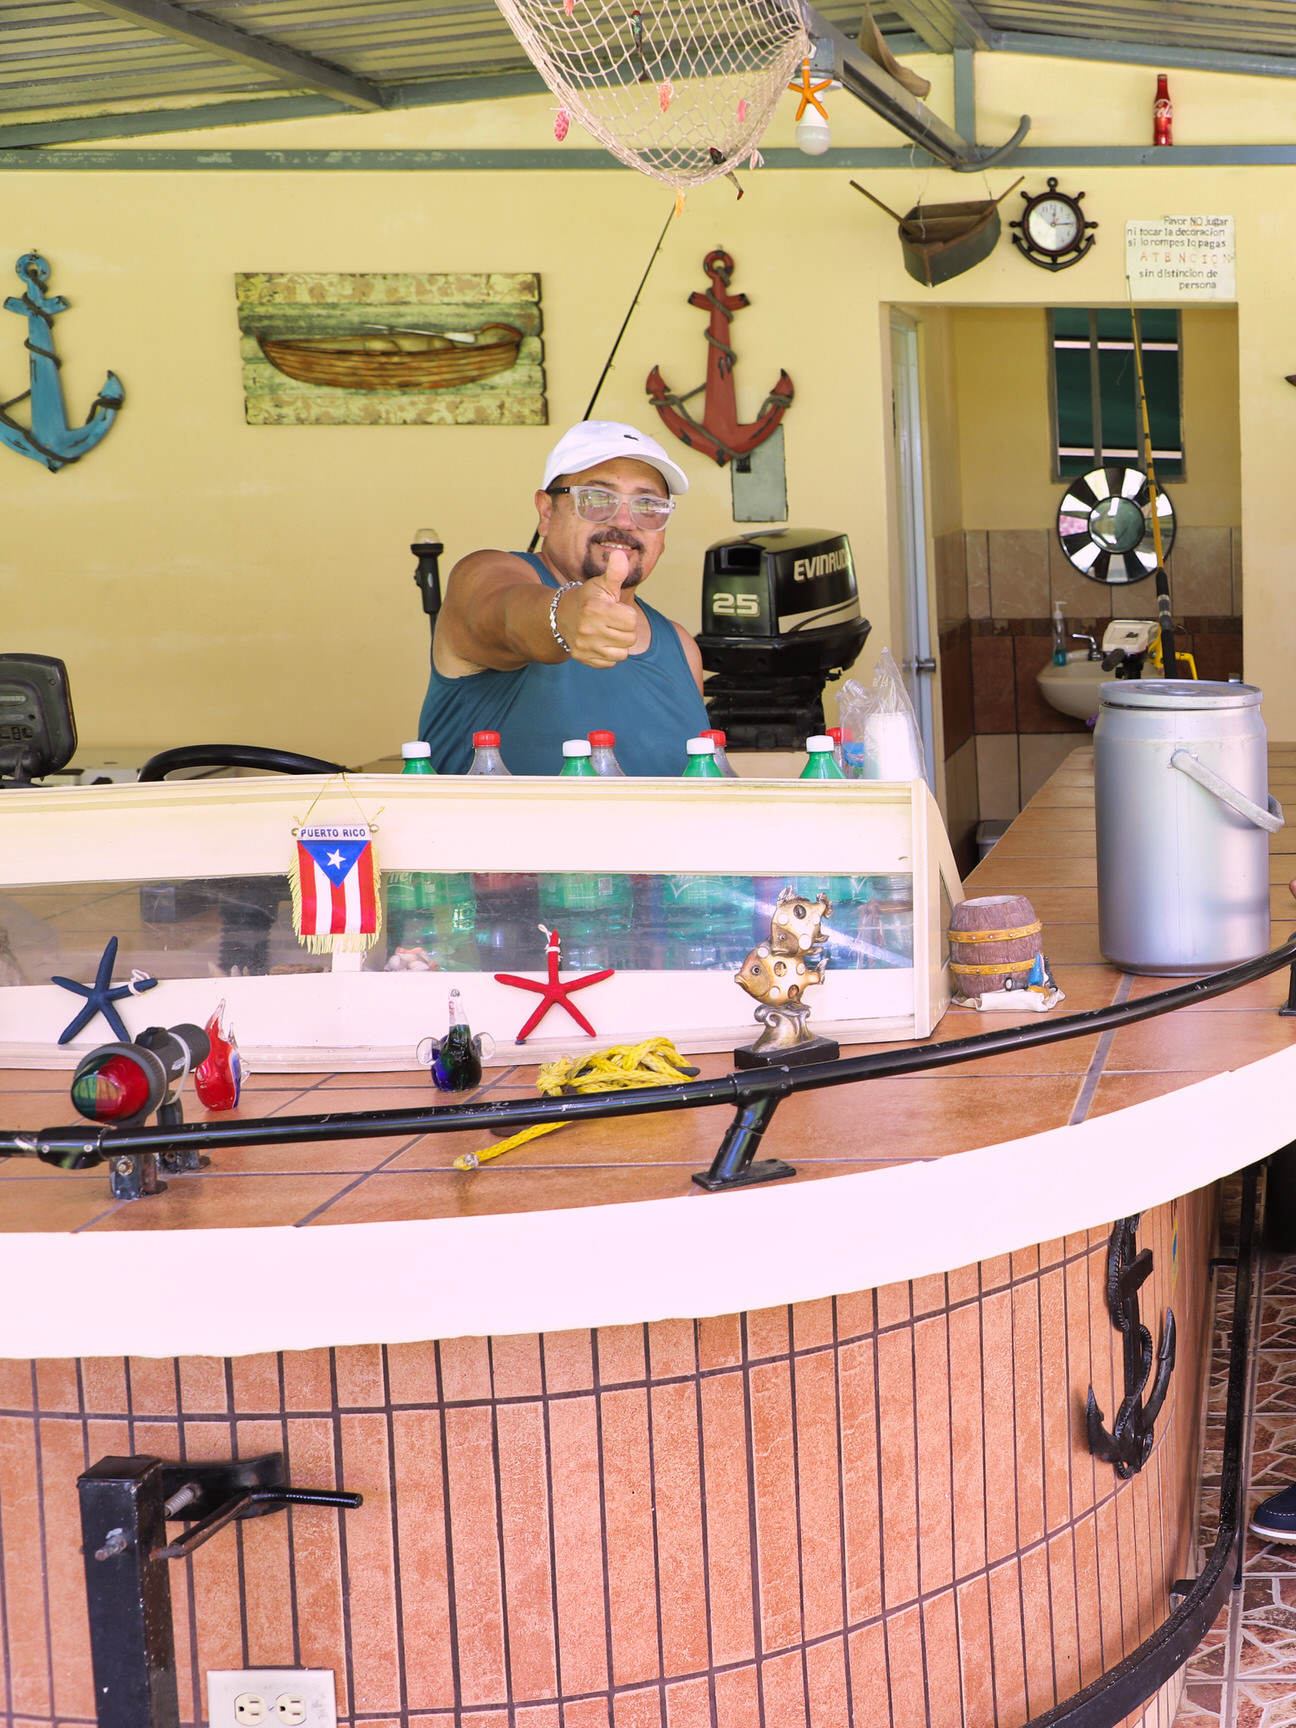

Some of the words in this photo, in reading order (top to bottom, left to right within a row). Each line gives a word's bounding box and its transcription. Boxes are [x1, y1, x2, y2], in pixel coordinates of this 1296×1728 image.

[1163, 215, 1188, 226] Favor
[1190, 216, 1203, 226] NO
[1127, 227, 1137, 237] ni
[1139, 228, 1163, 236] tocar
[1164, 228, 1173, 236] la
[1175, 228, 1226, 237] decoracion
[1127, 238, 1137, 247] si
[1150, 239, 1186, 248] rompes
[1197, 240, 1227, 250] pagas
[1138, 268, 1155, 278] sin
[1156, 268, 1204, 278] distincion
[1206, 269, 1219, 278] de
[1178, 281, 1217, 290] persona
[794, 549, 847, 582] EVINRUD
[713, 593, 760, 617] 25
[300, 829, 339, 838] PUERTO
[343, 828, 366, 837] RICO
